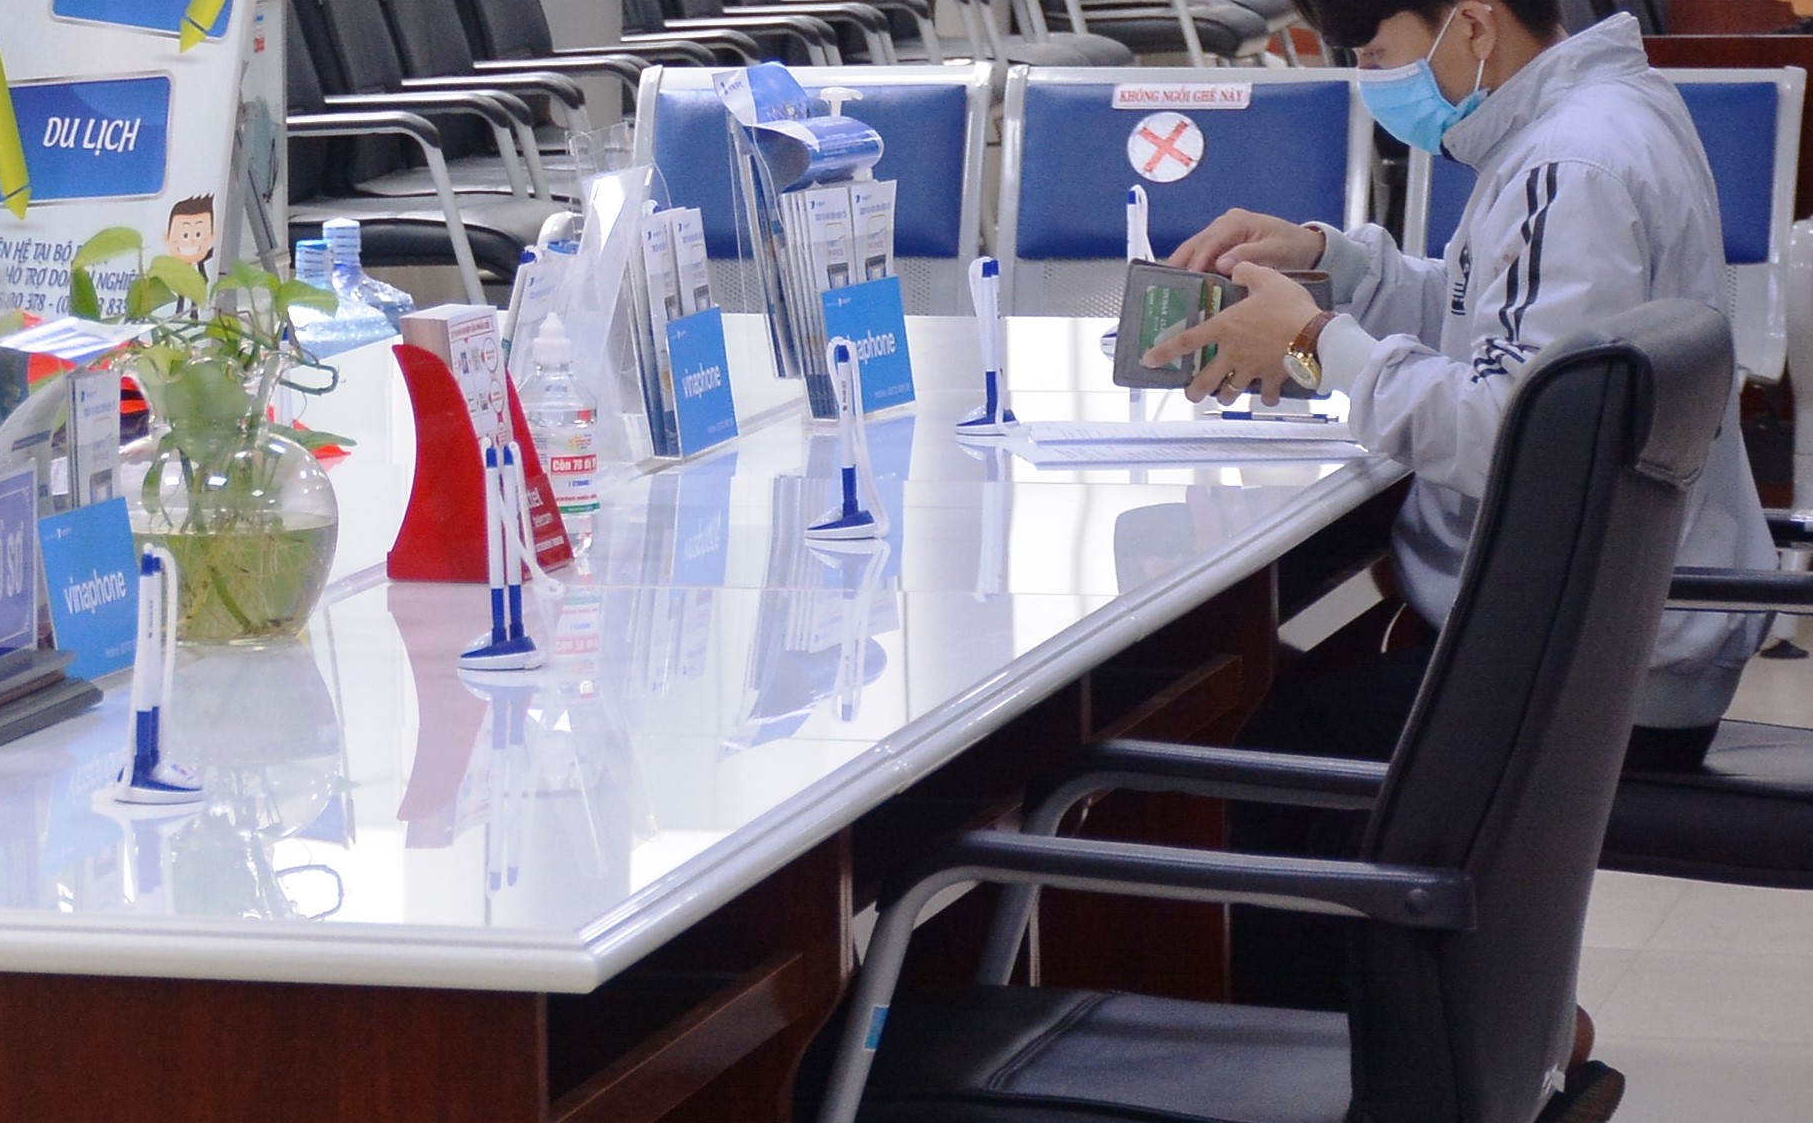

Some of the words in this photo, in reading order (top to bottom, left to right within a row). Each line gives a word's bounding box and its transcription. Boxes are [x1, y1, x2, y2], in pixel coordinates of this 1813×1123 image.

[1119, 88, 1159, 103] KHÔNG
[1219, 87, 1244, 103] NÀY
[43, 117, 77, 150] DU
[82, 117, 141, 156] LỊCH
[12, 237, 33, 263] HỆ
[32, 242, 49, 265] TẠI
[52, 240, 73, 268] BỘ
[681, 362, 722, 400] vinaphone
[64, 568, 126, 615] vinaphone
